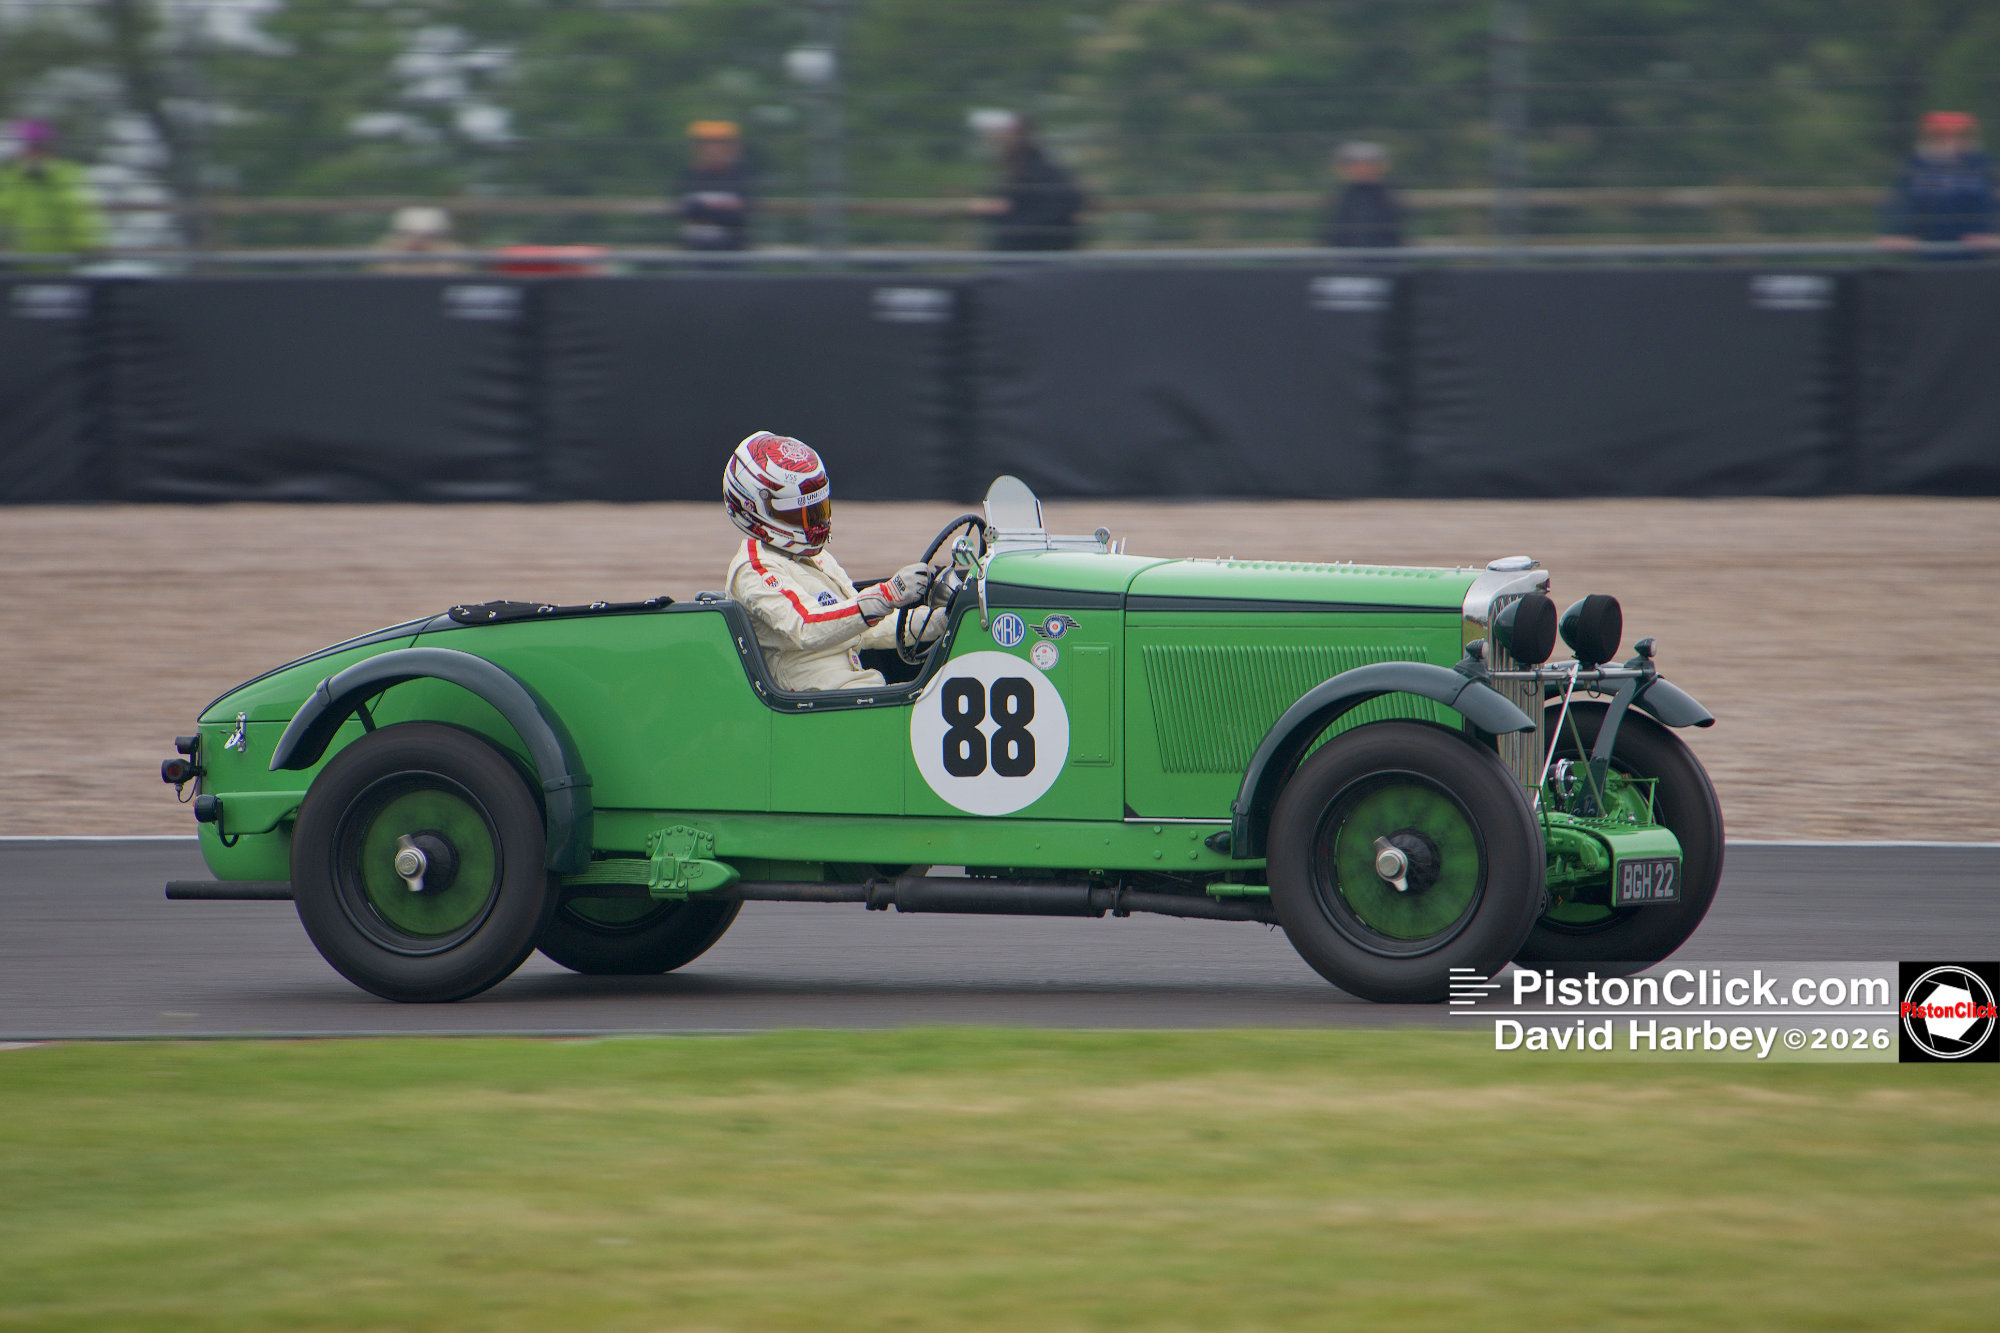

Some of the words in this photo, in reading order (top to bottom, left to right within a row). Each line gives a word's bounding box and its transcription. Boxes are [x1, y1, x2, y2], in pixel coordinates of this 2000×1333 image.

[995, 616, 1020, 645] MRL
[941, 677, 1036, 777] 88
[1623, 864, 1652, 899] BGH
[1655, 863, 1674, 897] 22
